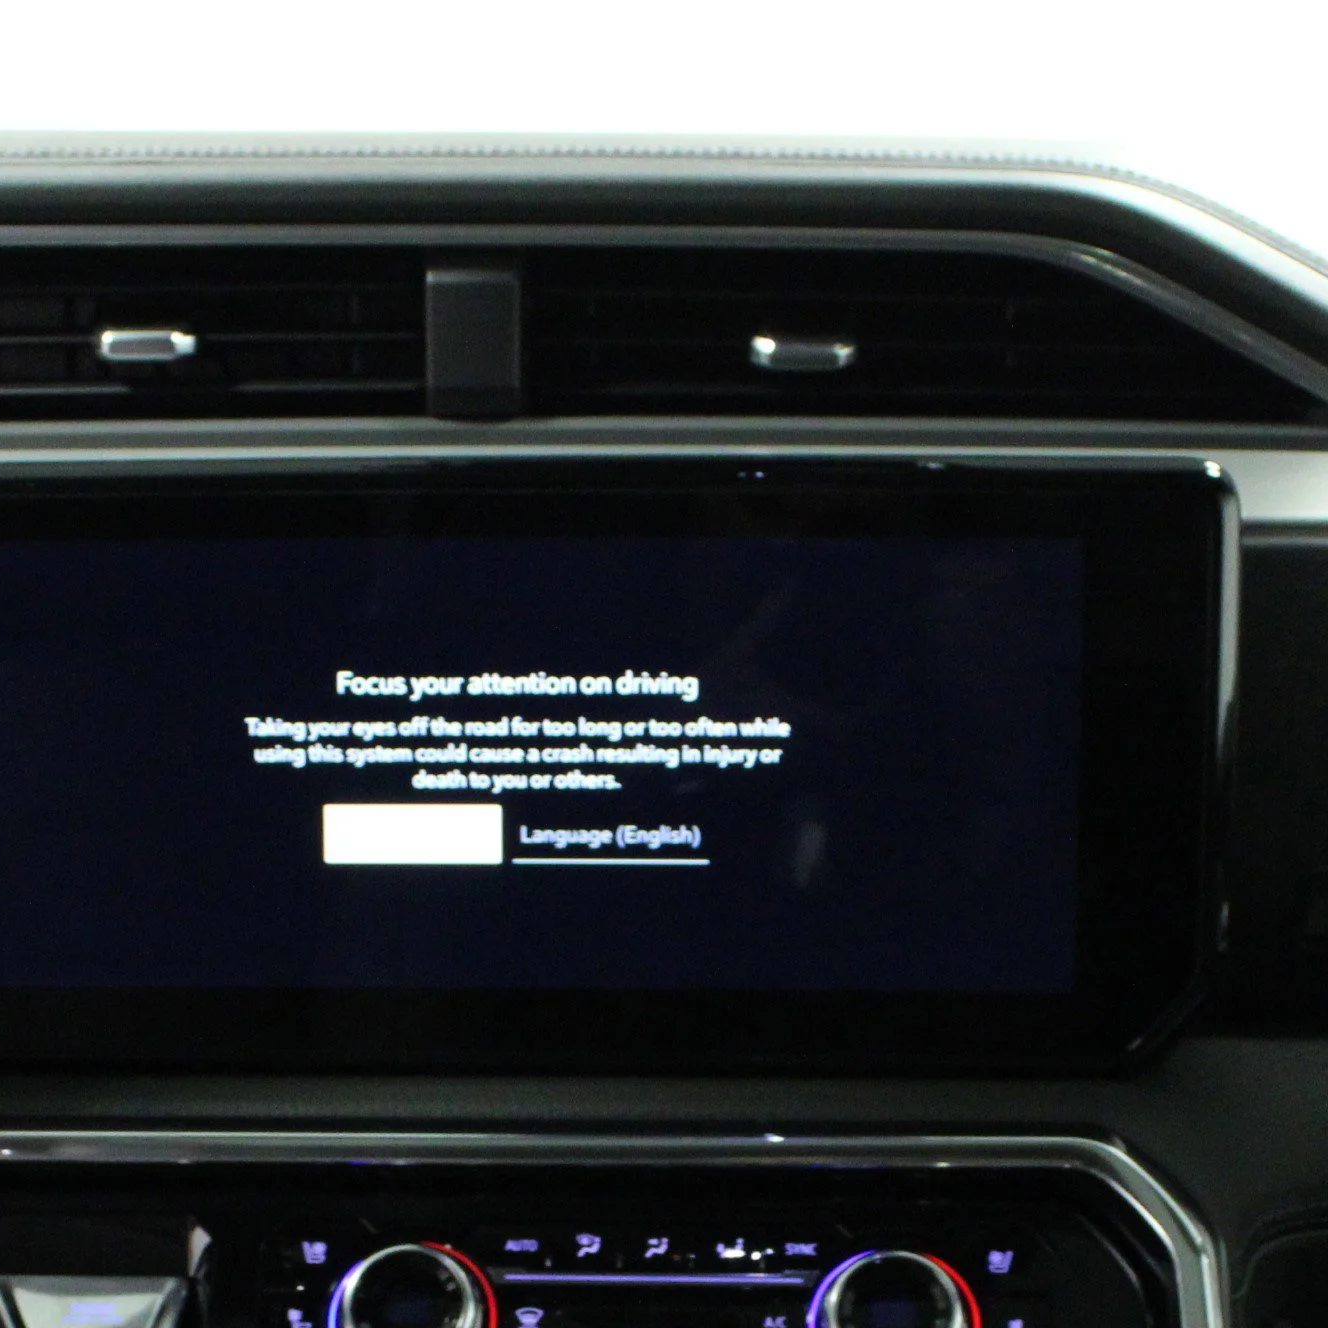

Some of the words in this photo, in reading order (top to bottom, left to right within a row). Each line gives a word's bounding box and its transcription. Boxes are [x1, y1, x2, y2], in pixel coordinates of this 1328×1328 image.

[336, 670, 408, 695] Focus
[409, 676, 465, 702] your
[467, 671, 577, 696] attention
[579, 676, 613, 695] on
[615, 669, 700, 702] driving
[244, 716, 307, 742] Taking
[308, 721, 351, 742] your
[352, 721, 398, 742] eyes
[398, 716, 430, 737] off
[430, 716, 463, 737] the
[464, 716, 509, 737] road
[510, 716, 541, 737] for
[542, 718, 577, 737] too
[578, 716, 622, 742] long
[623, 721, 647, 737] or
[648, 718, 683, 737] too
[684, 716, 738, 738] often
[739, 717, 792, 738] while
[253, 744, 307, 768] using
[308, 742, 344, 763] this
[345, 745, 413, 768] system
[414, 742, 468, 763] could
[469, 747, 525, 763] cause
[526, 748, 540, 763] a
[541, 742, 594, 763] crash
[595, 742, 680, 768] resulting
[681, 744, 702, 763] in
[703, 744, 758, 768] injury
[759, 748, 783, 763] or
[411, 769, 468, 789] death
[468, 771, 491, 789] to
[492, 774, 528, 794] you
[529, 774, 552, 789] or
[553, 769, 623, 789] others.
[520, 825, 614, 849] Language
[616, 825, 702, 849] (English)
